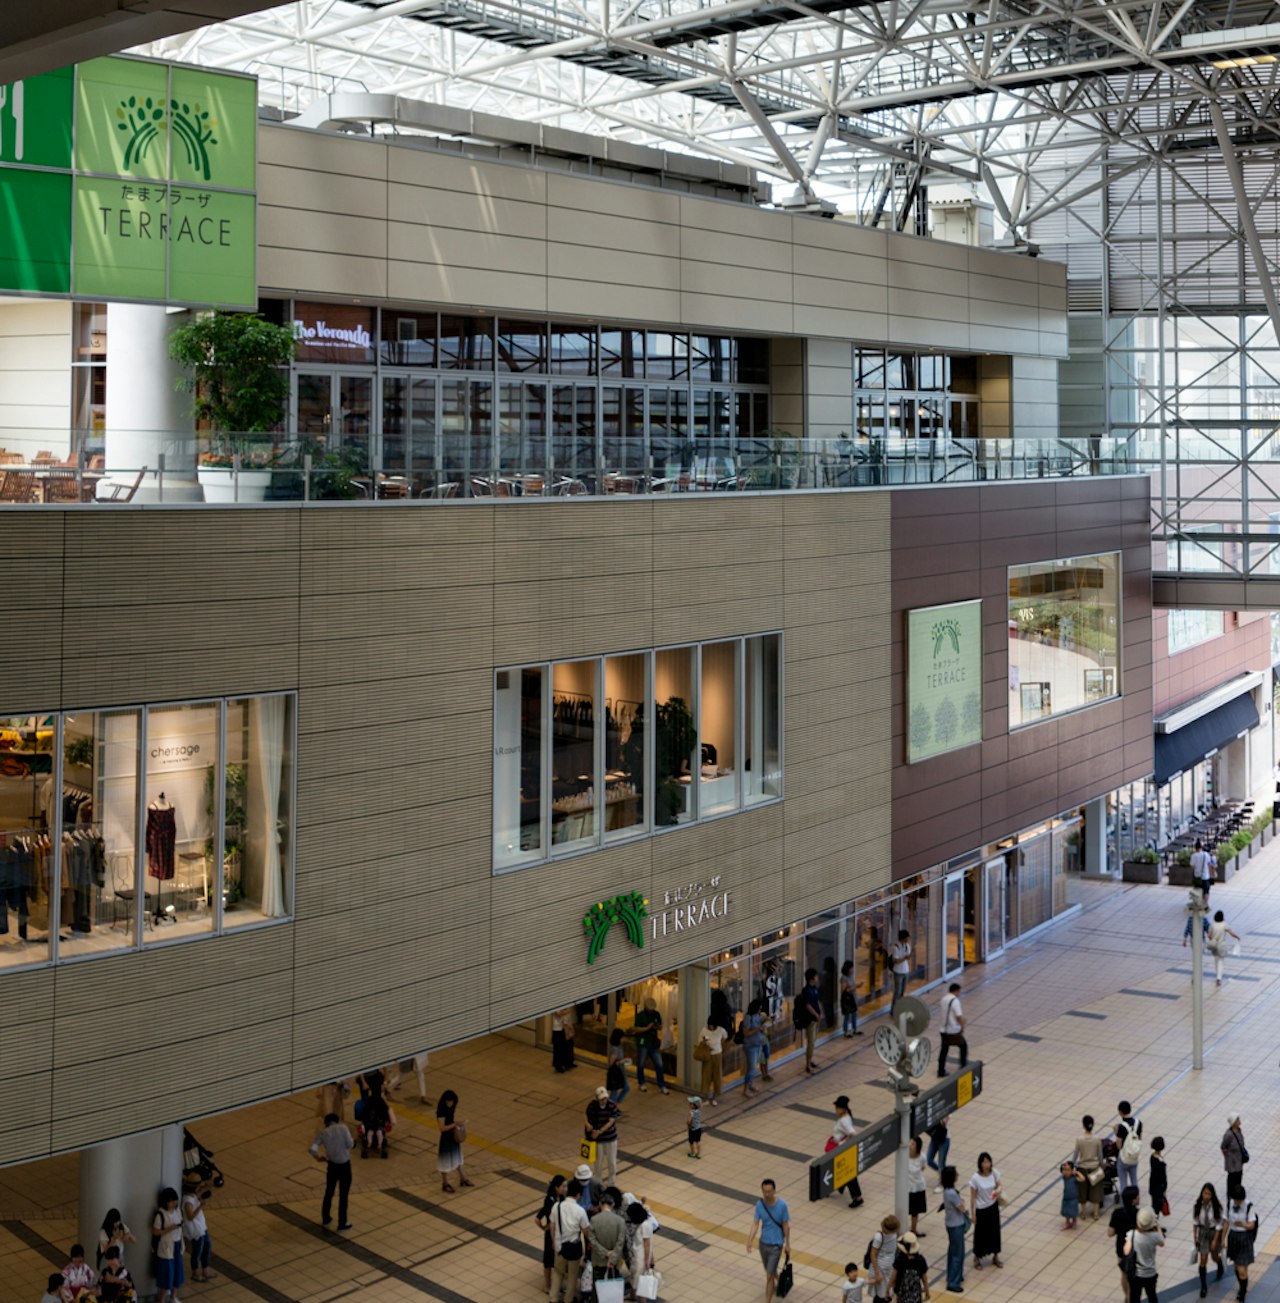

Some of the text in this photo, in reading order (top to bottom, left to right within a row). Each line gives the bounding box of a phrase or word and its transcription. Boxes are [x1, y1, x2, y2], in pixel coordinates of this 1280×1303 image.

[120, 184, 212, 209] たまプラーザ
[98, 207, 231, 247] TERRACE
[316, 320, 370, 348] Veranda
[927, 667, 966, 689] TERRACE
[150, 744, 200, 758] chersage
[650, 890, 732, 939] TERRACE
